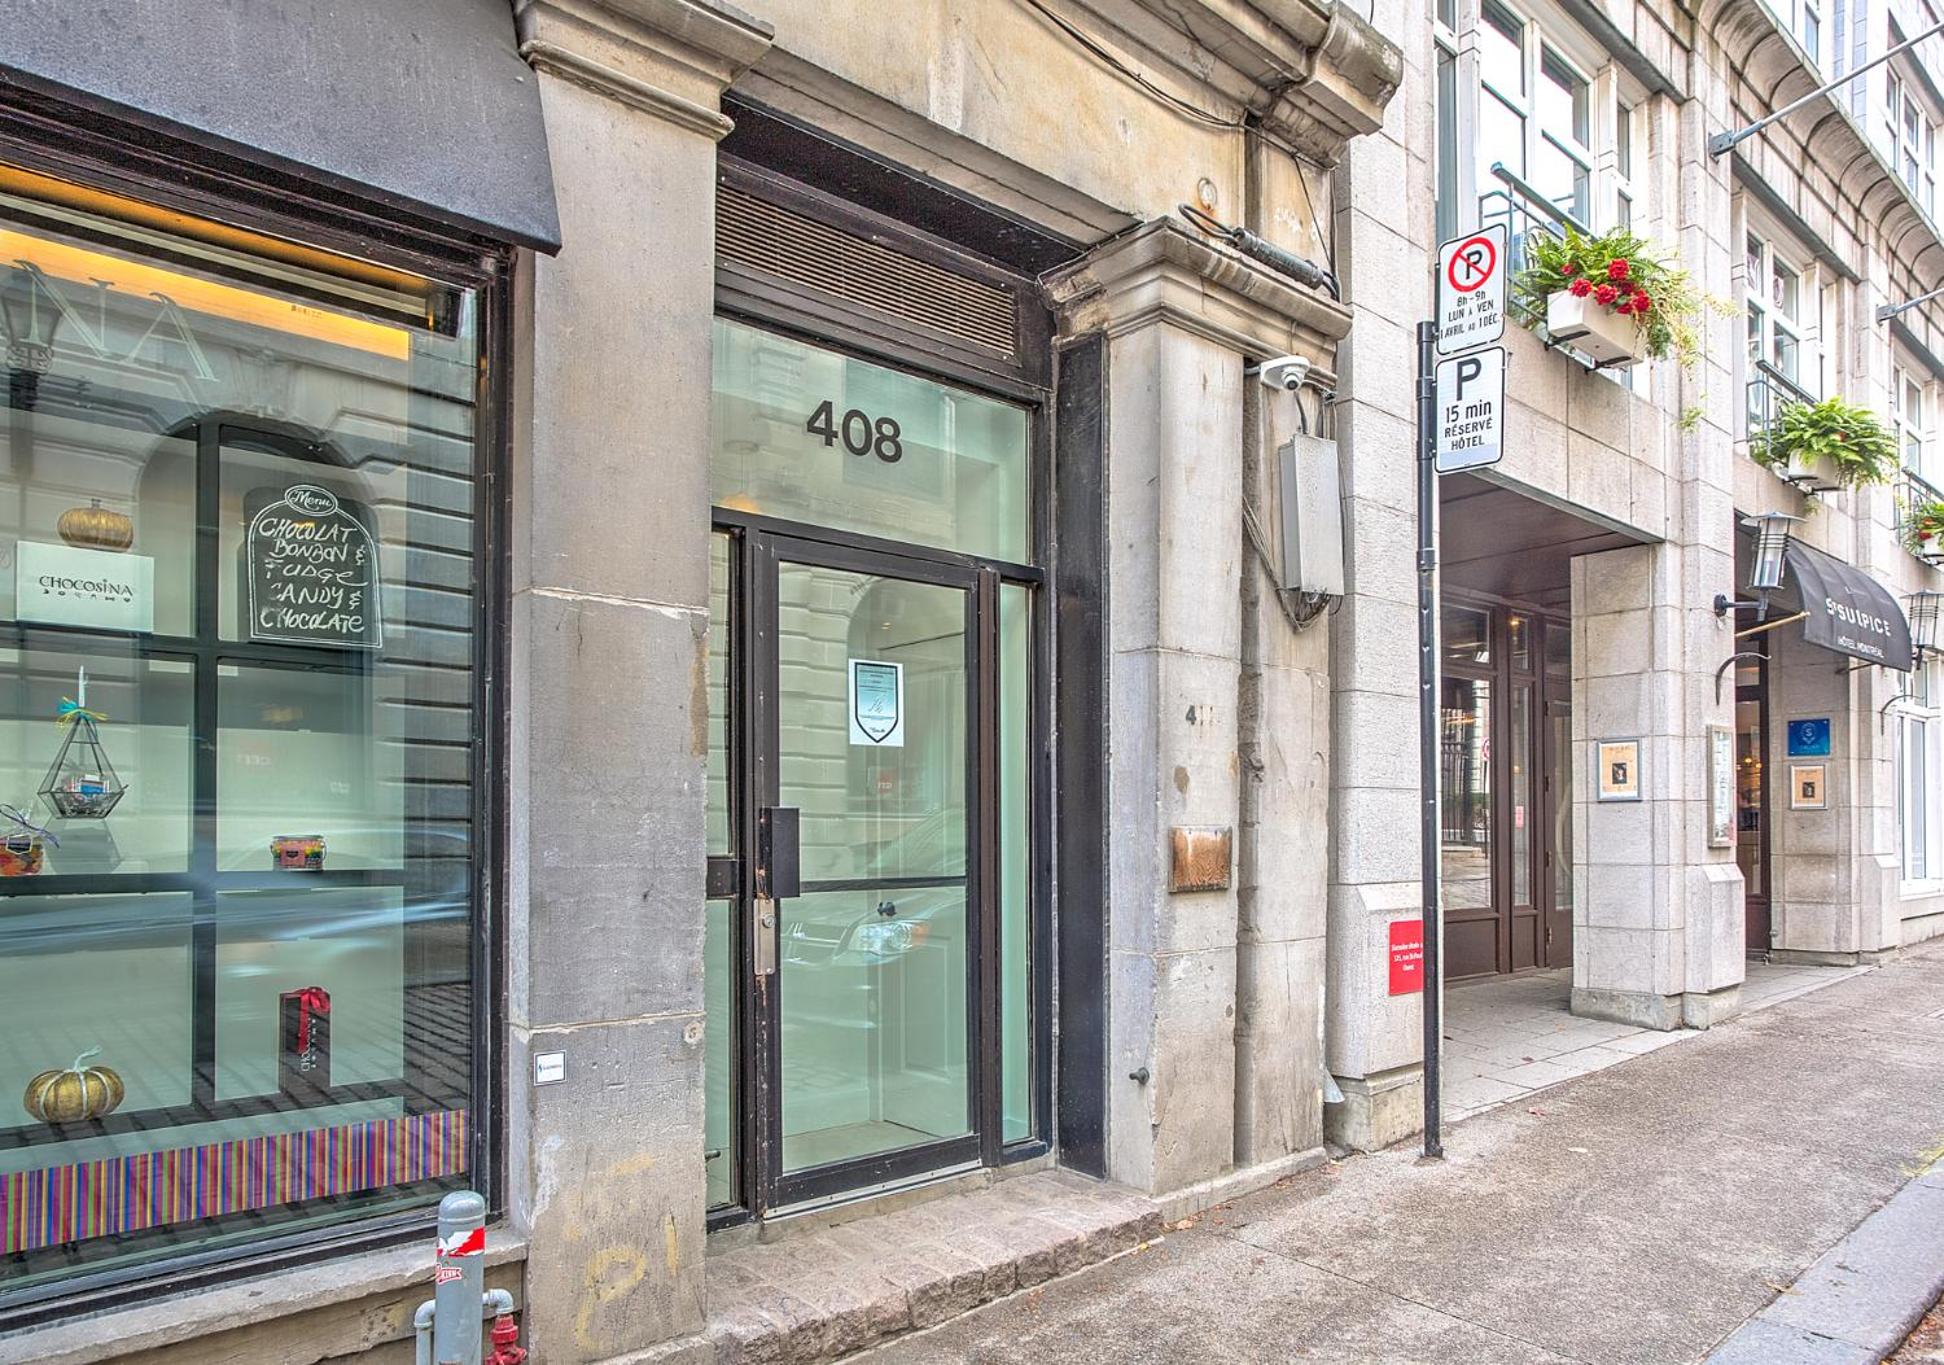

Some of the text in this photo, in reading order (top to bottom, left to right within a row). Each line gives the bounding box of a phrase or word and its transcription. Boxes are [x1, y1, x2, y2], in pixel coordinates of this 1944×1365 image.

[1448, 308, 1464, 322] LUN
[1477, 299, 1494, 313] VEN
[1444, 325, 1465, 339] AVRIL
[1456, 358, 1482, 401] P
[1446, 399, 1492, 423] 15 min
[806, 400, 903, 463] 408
[1444, 417, 1493, 438] RÉSERVÉ
[1451, 435, 1485, 451] HÔTEL
[288, 490, 333, 511] Menu
[259, 518, 358, 543] CHOCOLAT
[269, 538, 349, 564] BONBON
